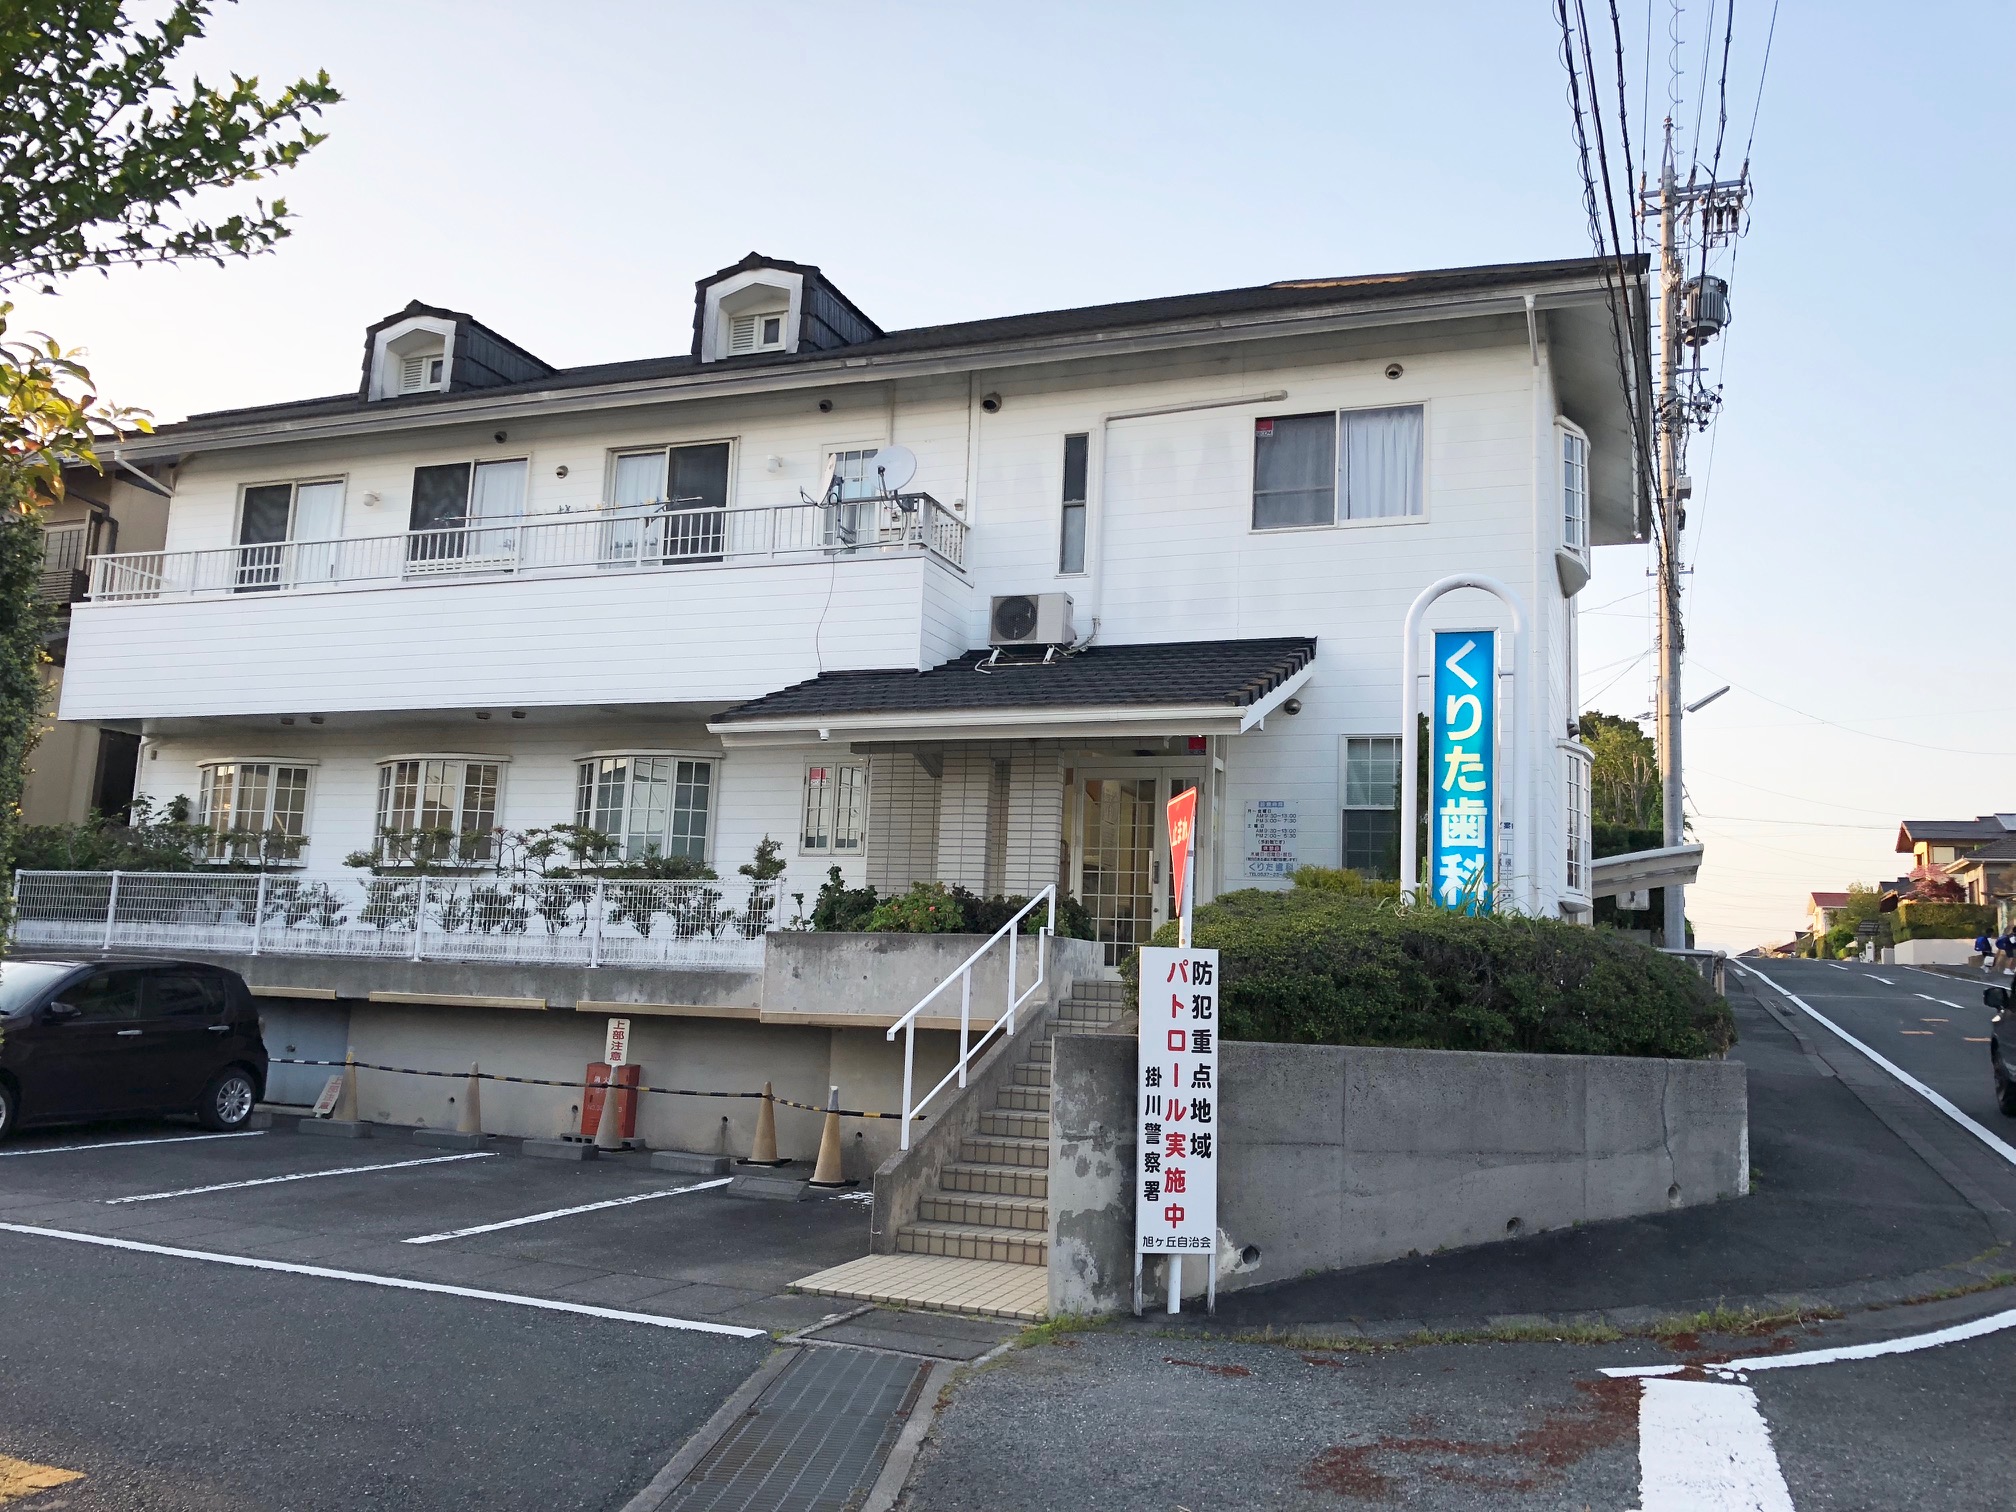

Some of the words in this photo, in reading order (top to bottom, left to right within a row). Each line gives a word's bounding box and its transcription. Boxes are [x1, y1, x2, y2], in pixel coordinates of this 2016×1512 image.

[1438, 638, 1489, 907] くりた歯科
[1248, 862, 1294, 872] くりた歯科
[609, 1020, 625, 1062] 上部注意
[1164, 959, 1189, 1230] パトロール実施中
[1190, 960, 1213, 1160] 防犯重点地域
[1143, 1066, 1162, 1202] 掛川警察署
